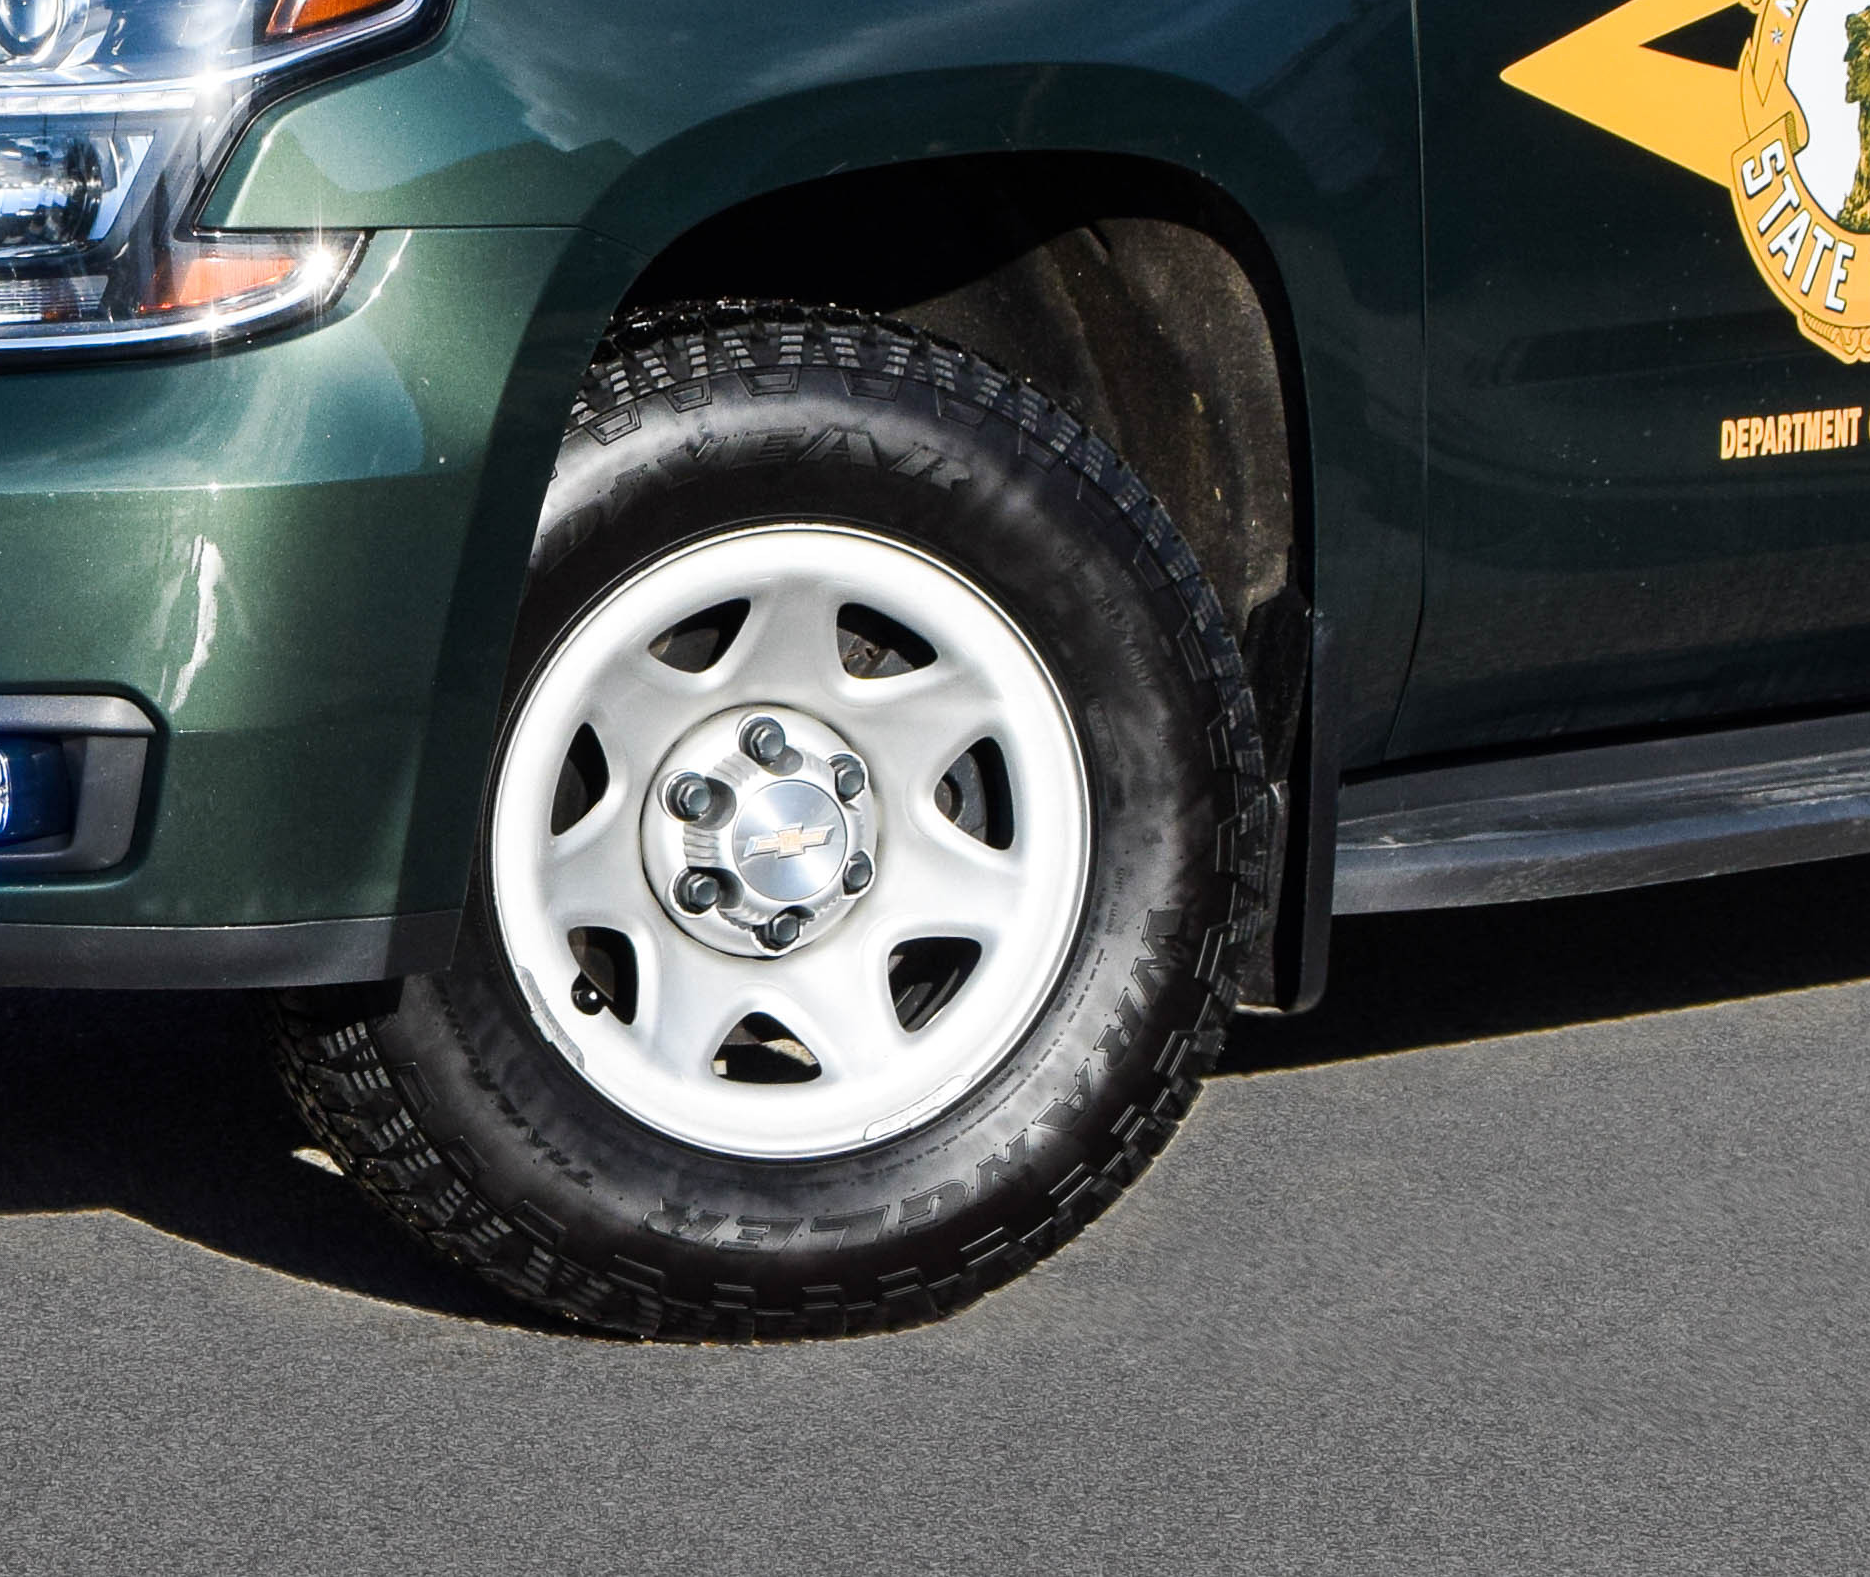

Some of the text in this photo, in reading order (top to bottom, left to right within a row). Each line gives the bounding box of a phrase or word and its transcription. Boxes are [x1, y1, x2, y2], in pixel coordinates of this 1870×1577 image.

[1741, 138, 1856, 313] STATE
[1720, 406, 1863, 460] DEPARTMENT
[642, 907, 1185, 1255] WRANGLER
